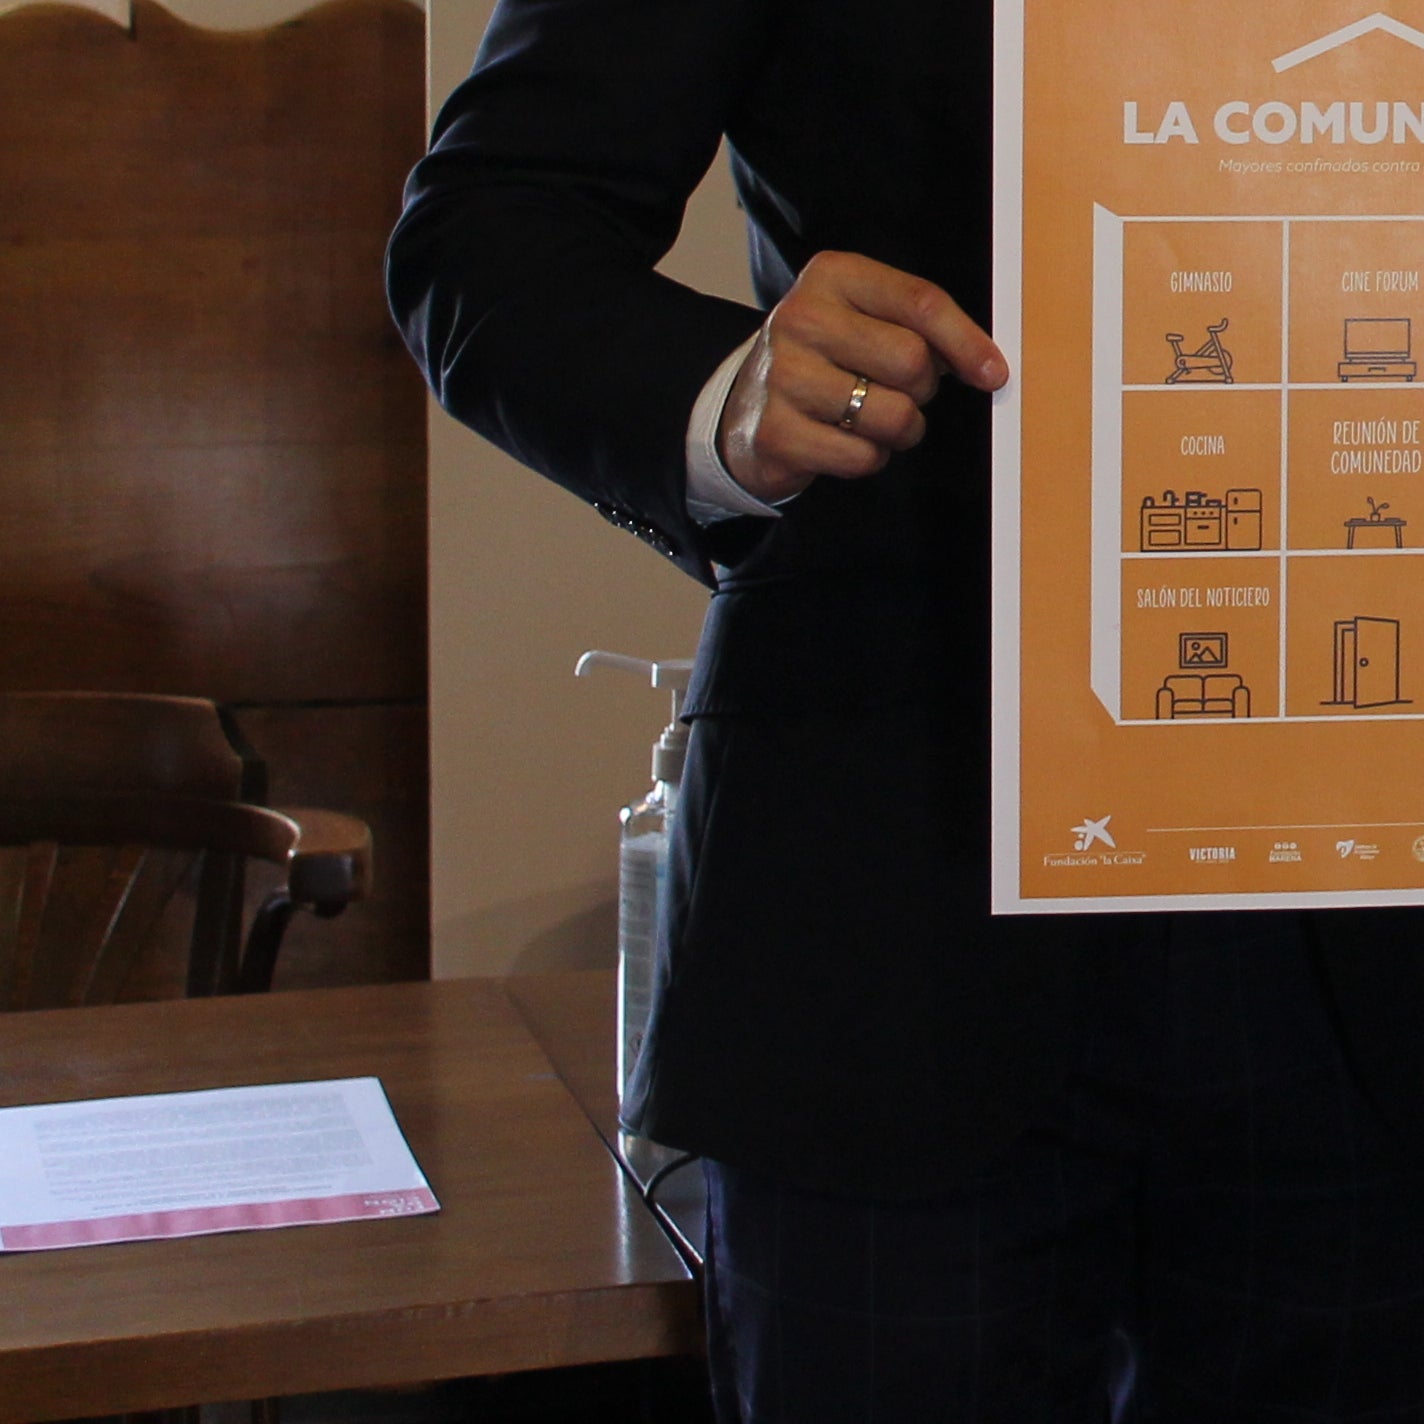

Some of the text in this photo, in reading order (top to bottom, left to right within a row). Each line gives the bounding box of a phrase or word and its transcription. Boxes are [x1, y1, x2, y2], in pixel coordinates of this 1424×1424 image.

[1124, 102, 1199, 144] LA
[1219, 159, 1282, 175] Mayores
[1287, 158, 1369, 172] confinados
[1372, 158, 1419, 173] contra
[1171, 272, 1232, 292] GIMNASIO
[1342, 271, 1418, 292] CINE FORUM
[1334, 417, 1420, 445] REUNIÓN DE
[1181, 436, 1224, 455] COCINA
[1331, 450, 1421, 474] COMUNEDAD
[1137, 586, 1269, 608] SALÓN DEL NOTICIERO
[1044, 854, 1098, 866] Fundación
[1190, 848, 1235, 860] VICTORIA
